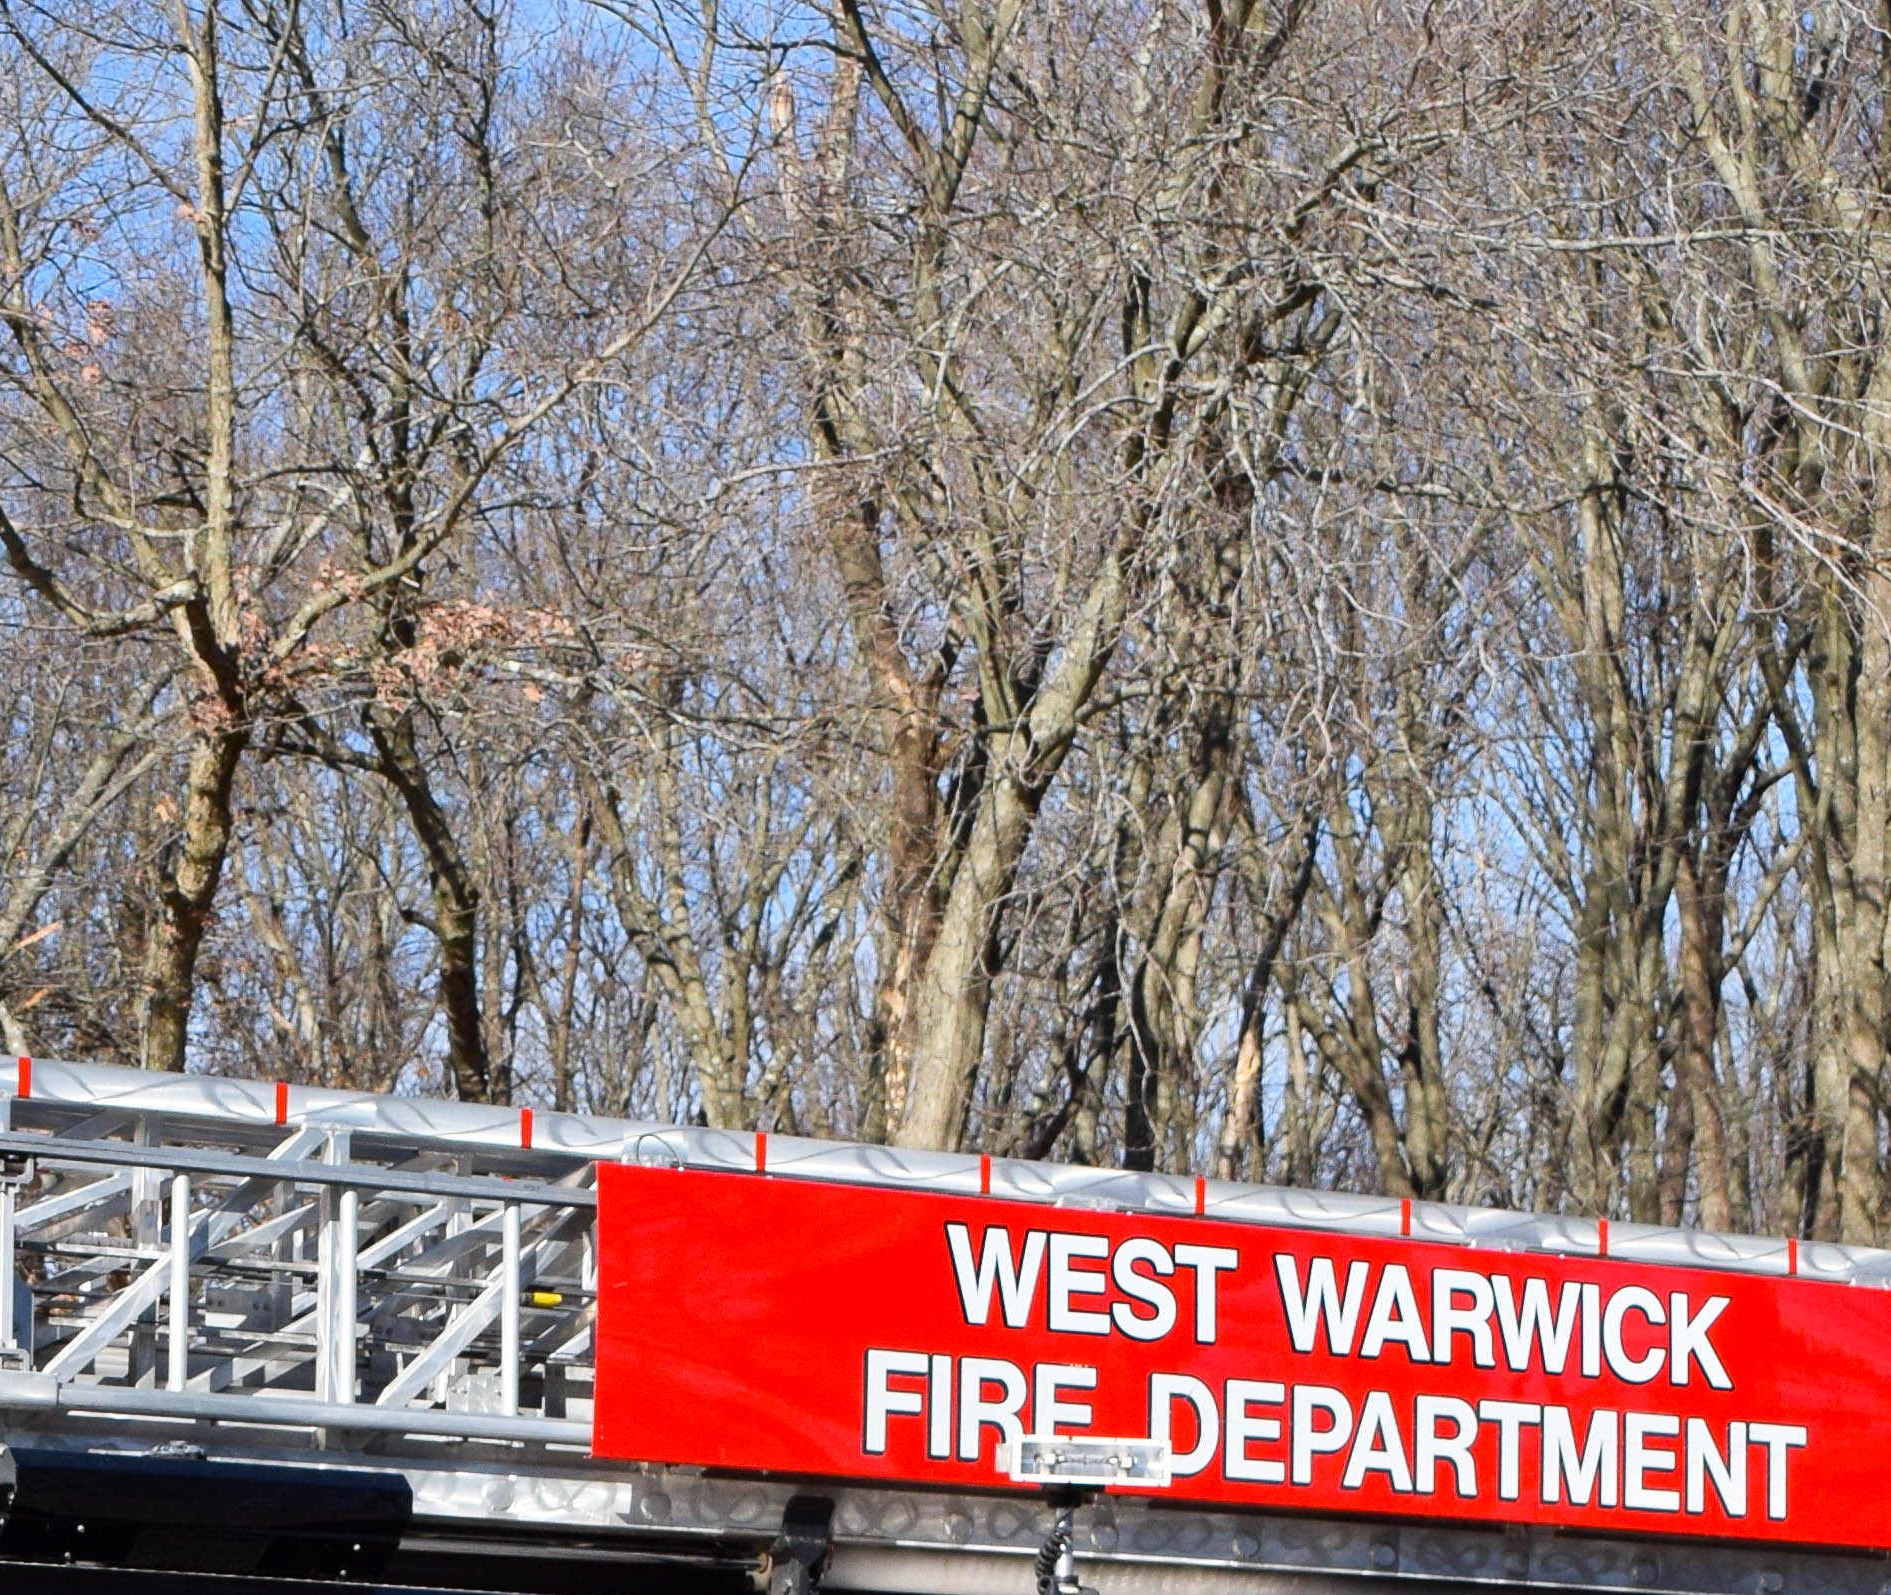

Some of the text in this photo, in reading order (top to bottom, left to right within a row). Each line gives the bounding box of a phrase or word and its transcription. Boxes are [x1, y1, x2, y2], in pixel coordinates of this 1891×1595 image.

[945, 1222, 1733, 1389] WEST WARWICK
[863, 1349, 1807, 1520] FIRE DEPARTMENT
